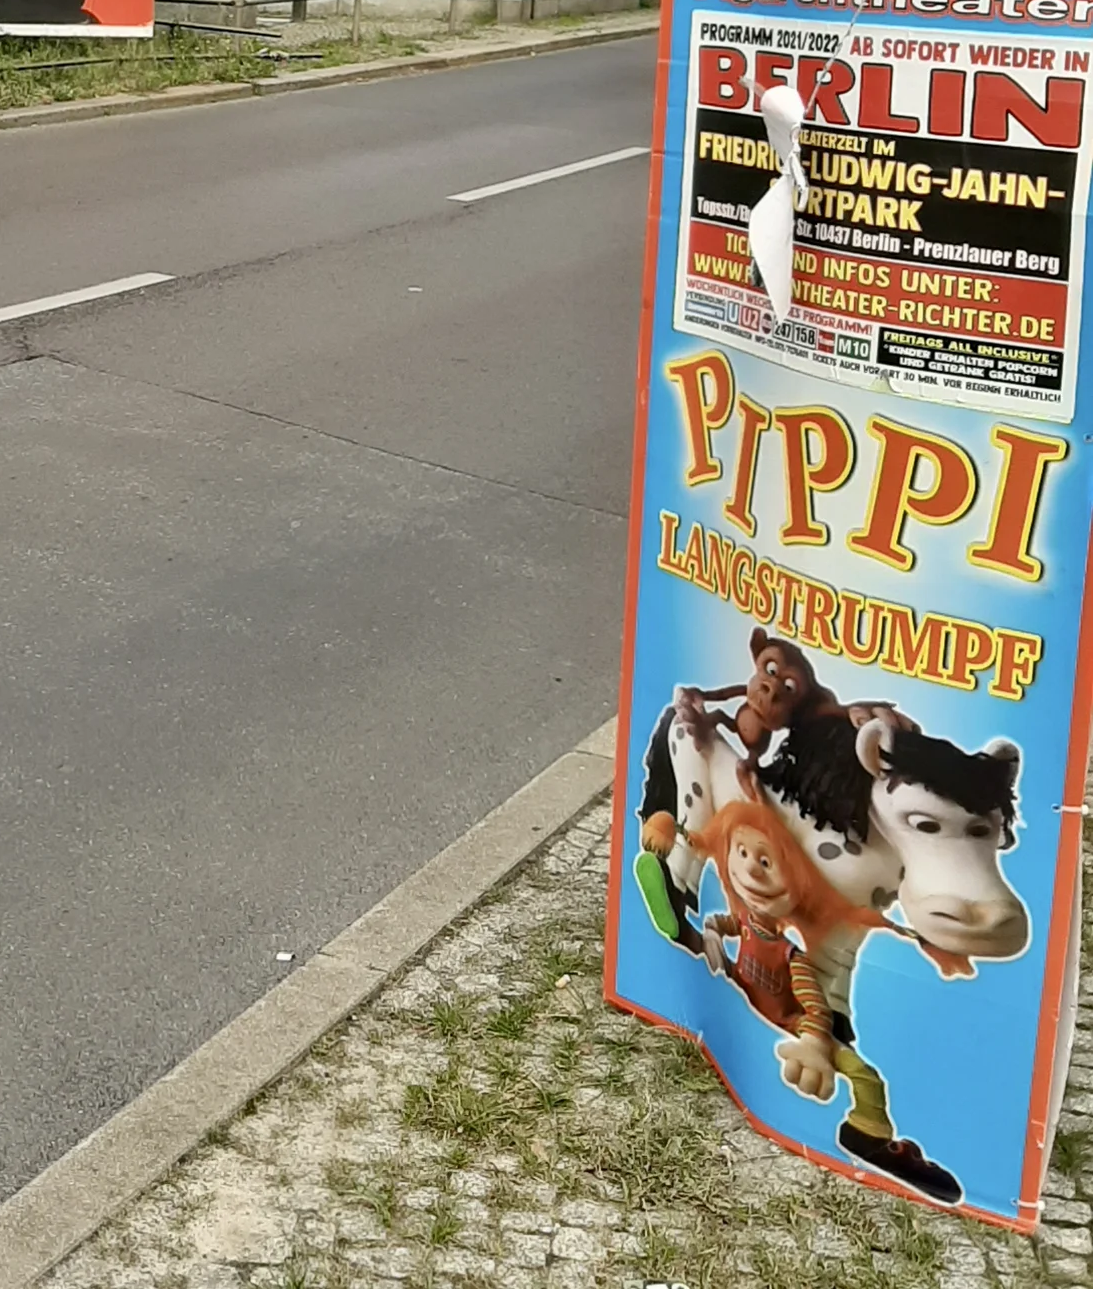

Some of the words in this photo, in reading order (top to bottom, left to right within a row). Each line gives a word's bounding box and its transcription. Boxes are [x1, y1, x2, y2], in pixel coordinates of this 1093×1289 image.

[700, 23, 773, 47] PROGRAMM
[777, 29, 840, 54] 2021/2022
[850, 36, 874, 57] AB
[881, 39, 960, 64] SOFORT
[969, 43, 1056, 71] WIEDER
[1064, 50, 1090, 73] IN
[698, 45, 1086, 149] BERLIN
[873, 138, 895, 156] IM
[814, 222, 850, 245] 10437
[851, 230, 901, 253] Berlin
[912, 236, 1014, 268] Prenzlauer
[1014, 248, 1060, 275] Berg
[793, 250, 817, 273] ND
[823, 257, 891, 288] INFOS
[901, 269, 1001, 303] UNTER:
[742, 307, 759, 331] U2
[795, 326, 816, 346] 158
[838, 337, 869, 358] M10
[803, 311, 873, 336] PROGRAMM!
[884, 331, 944, 349] FREITAGS
[948, 341, 973, 354] ALL
[899, 356, 925, 368] UND
[928, 361, 985, 377] GETRÄNK
[989, 370, 1037, 385] GRATIS!
[934, 351, 995, 368] ERHALTEN
[997, 360, 1058, 378] POPCORN
[942, 377, 962, 390] VOR
[664, 348, 1068, 583] PIPPI
[657, 508, 1042, 701] LANGSTRUMPF
